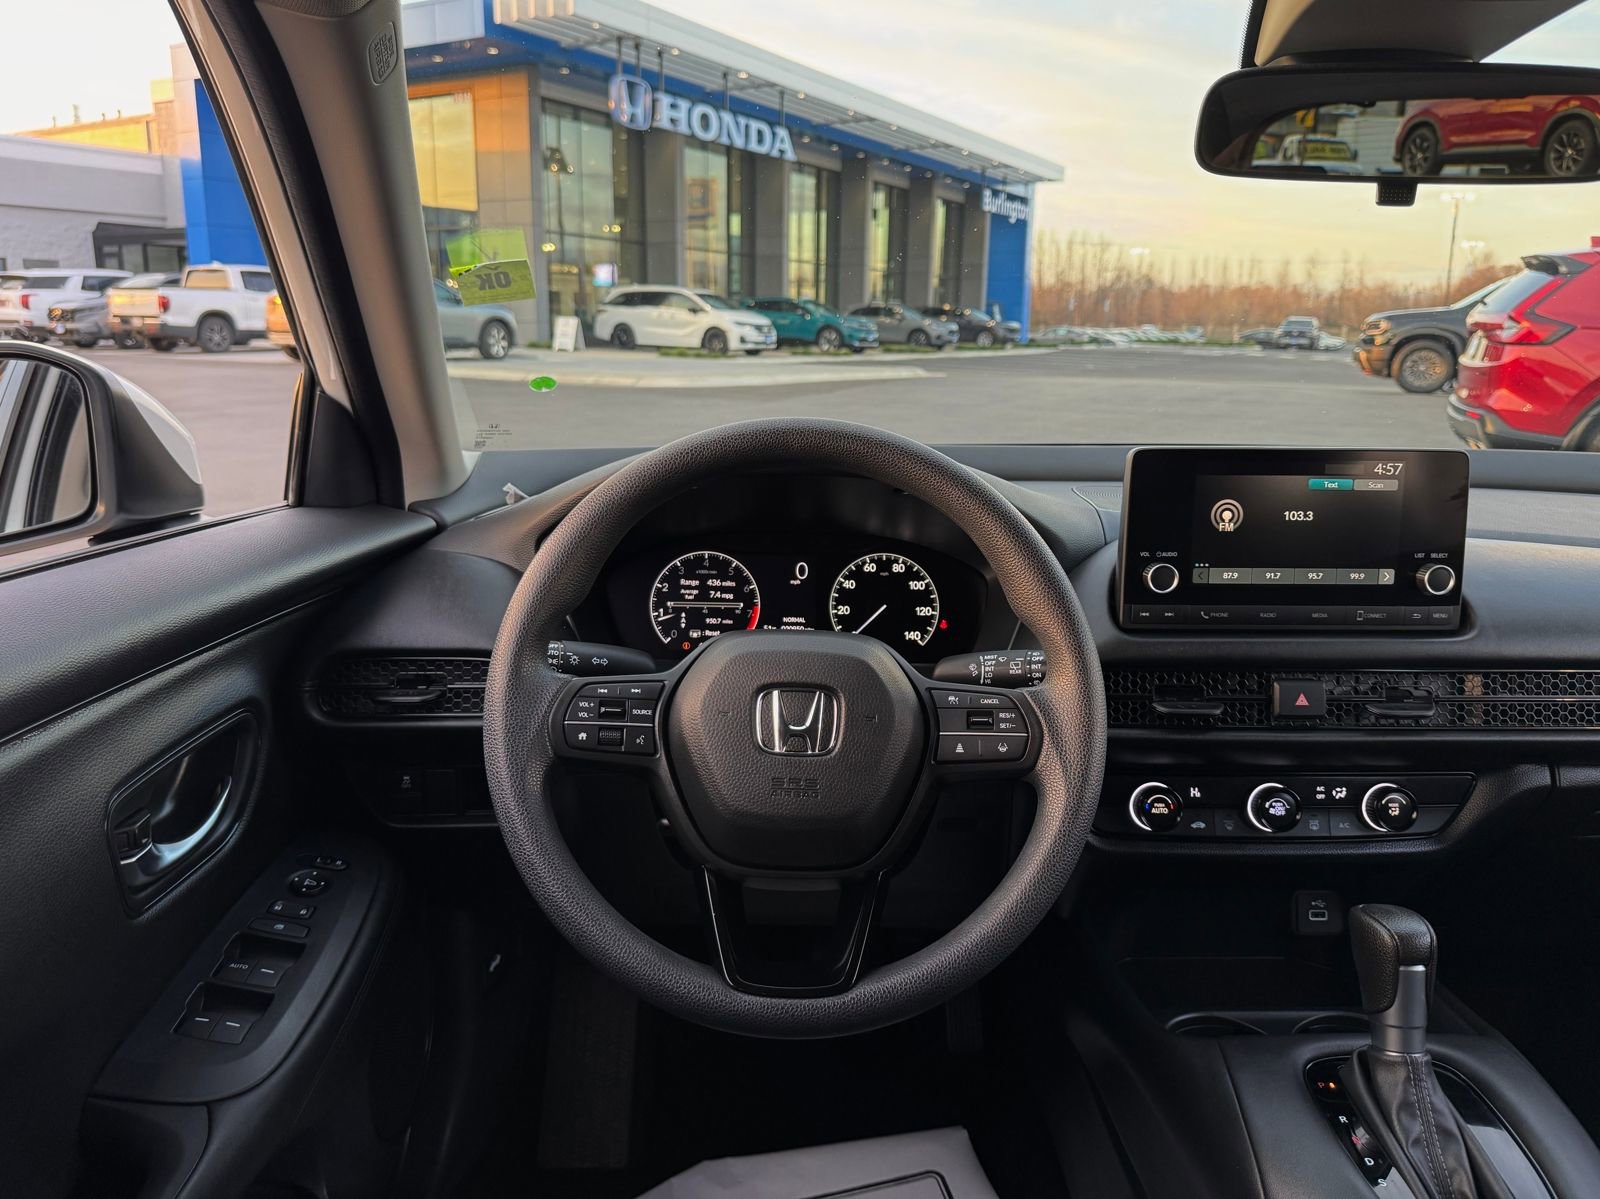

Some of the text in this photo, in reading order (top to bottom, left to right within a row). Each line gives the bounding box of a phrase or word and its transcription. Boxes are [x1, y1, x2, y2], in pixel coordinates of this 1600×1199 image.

[654, 92, 797, 161] HONDA
[1374, 463, 1404, 476] 4:57
[1324, 481, 1338, 489] Text
[1283, 511, 1314, 521] 103.3
[1219, 522, 1234, 532] FM
[679, 566, 685, 575] 3
[728, 567, 734, 576] 5
[795, 562, 808, 580] 0
[864, 563, 876, 572] 60
[892, 563, 905, 572] 80
[662, 583, 669, 592] 2
[680, 579, 700, 587] Range
[842, 580, 856, 589] 40
[909, 580, 925, 590] 100
[744, 584, 750, 592] 6
[659, 608, 664, 616] 1
[837, 606, 850, 615] 20
[916, 607, 932, 616] 120
[671, 629, 677, 638] 0
[904, 631, 921, 641] 140
[229, 962, 249, 970] AUTO
[1338, 1115, 1348, 1123] R
[1364, 1157, 1375, 1166] D
[1378, 1178, 1387, 1187] S
